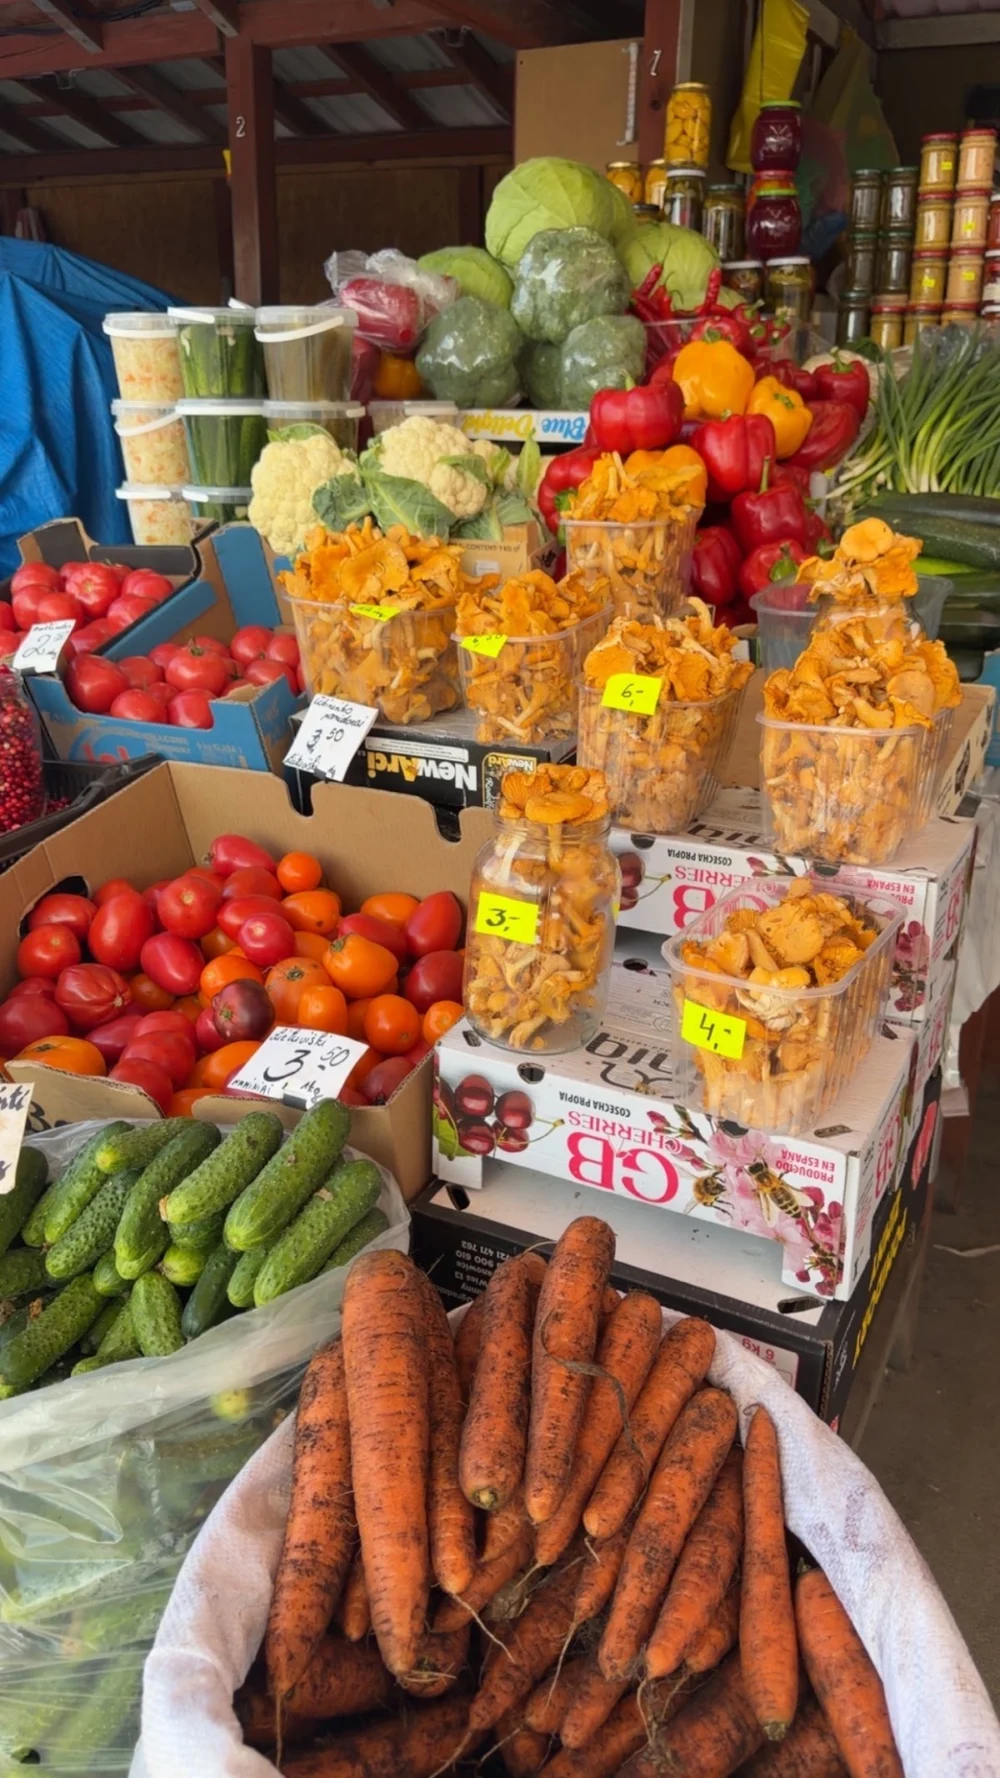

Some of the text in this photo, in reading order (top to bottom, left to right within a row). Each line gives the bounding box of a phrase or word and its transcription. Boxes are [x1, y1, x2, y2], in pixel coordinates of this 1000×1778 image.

[236, 115, 246, 138] 2
[541, 415, 586, 441] Blue
[22, 634, 51, 658] 2
[367, 752, 477, 791] NewArci
[667, 848, 733, 867] COSECHA PROPIA
[558, 1091, 631, 1118] COSECHA PROPIA
[568, 1110, 683, 1153] CHERRIES
[566, 1131, 679, 1204] GB
[775, 1160, 835, 1184] PRODUCIDO
[821, 1160, 836, 1172] EN
[742, 1338, 775, 1360] 6 kg
